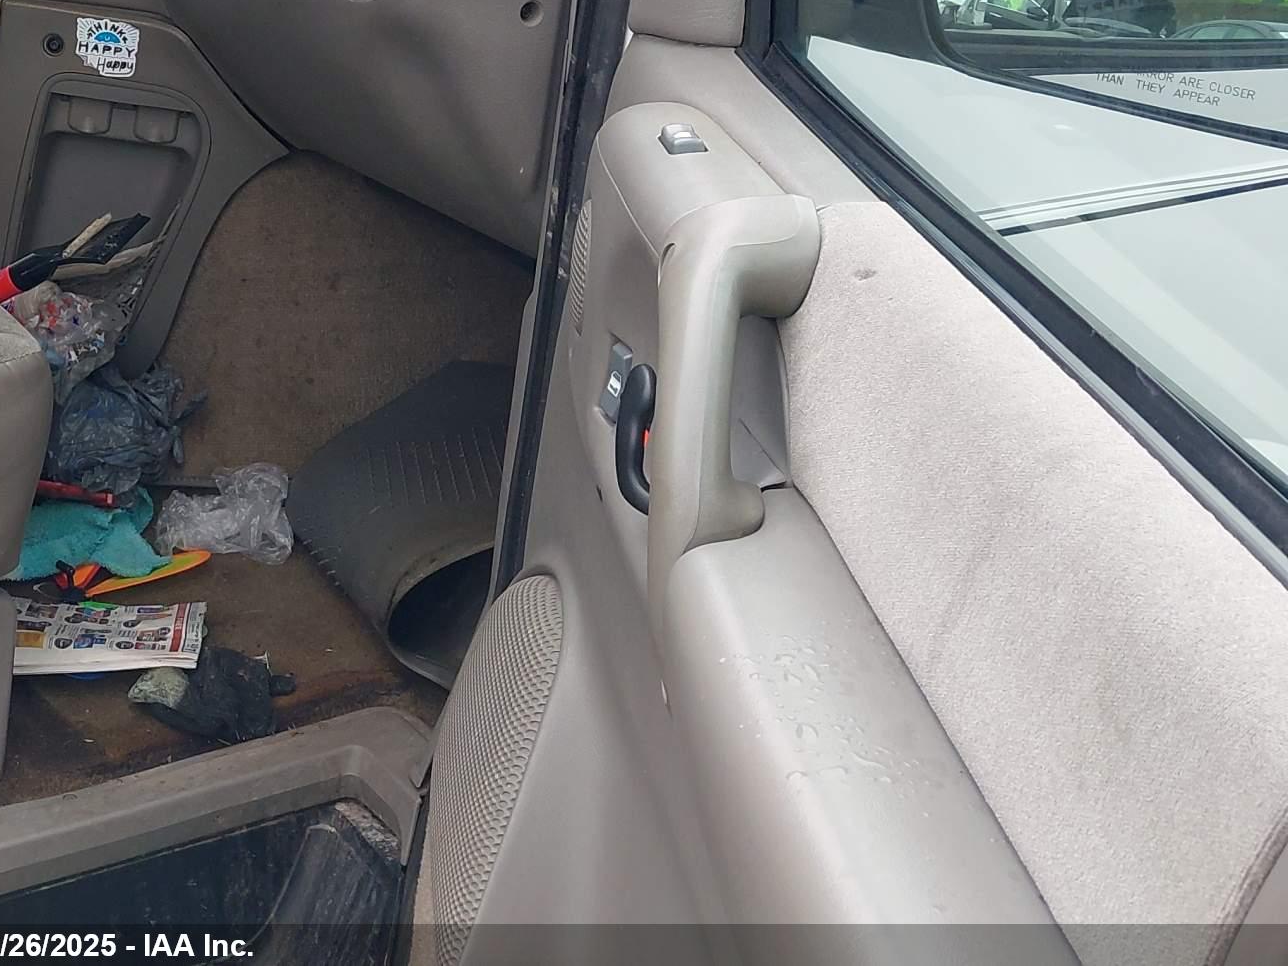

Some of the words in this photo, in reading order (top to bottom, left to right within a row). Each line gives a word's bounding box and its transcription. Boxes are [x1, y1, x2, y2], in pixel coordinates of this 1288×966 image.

[87, 20, 127, 38] THINK
[78, 40, 136, 58] HAPPY
[97, 56, 134, 74] Happy
[1096, 72, 1125, 86] THAN
[1135, 79, 1166, 94] THEY
[1172, 88, 1221, 107] APPEAR
[1179, 75, 1206, 90] ARE
[1209, 81, 1257, 101] CLOSER
